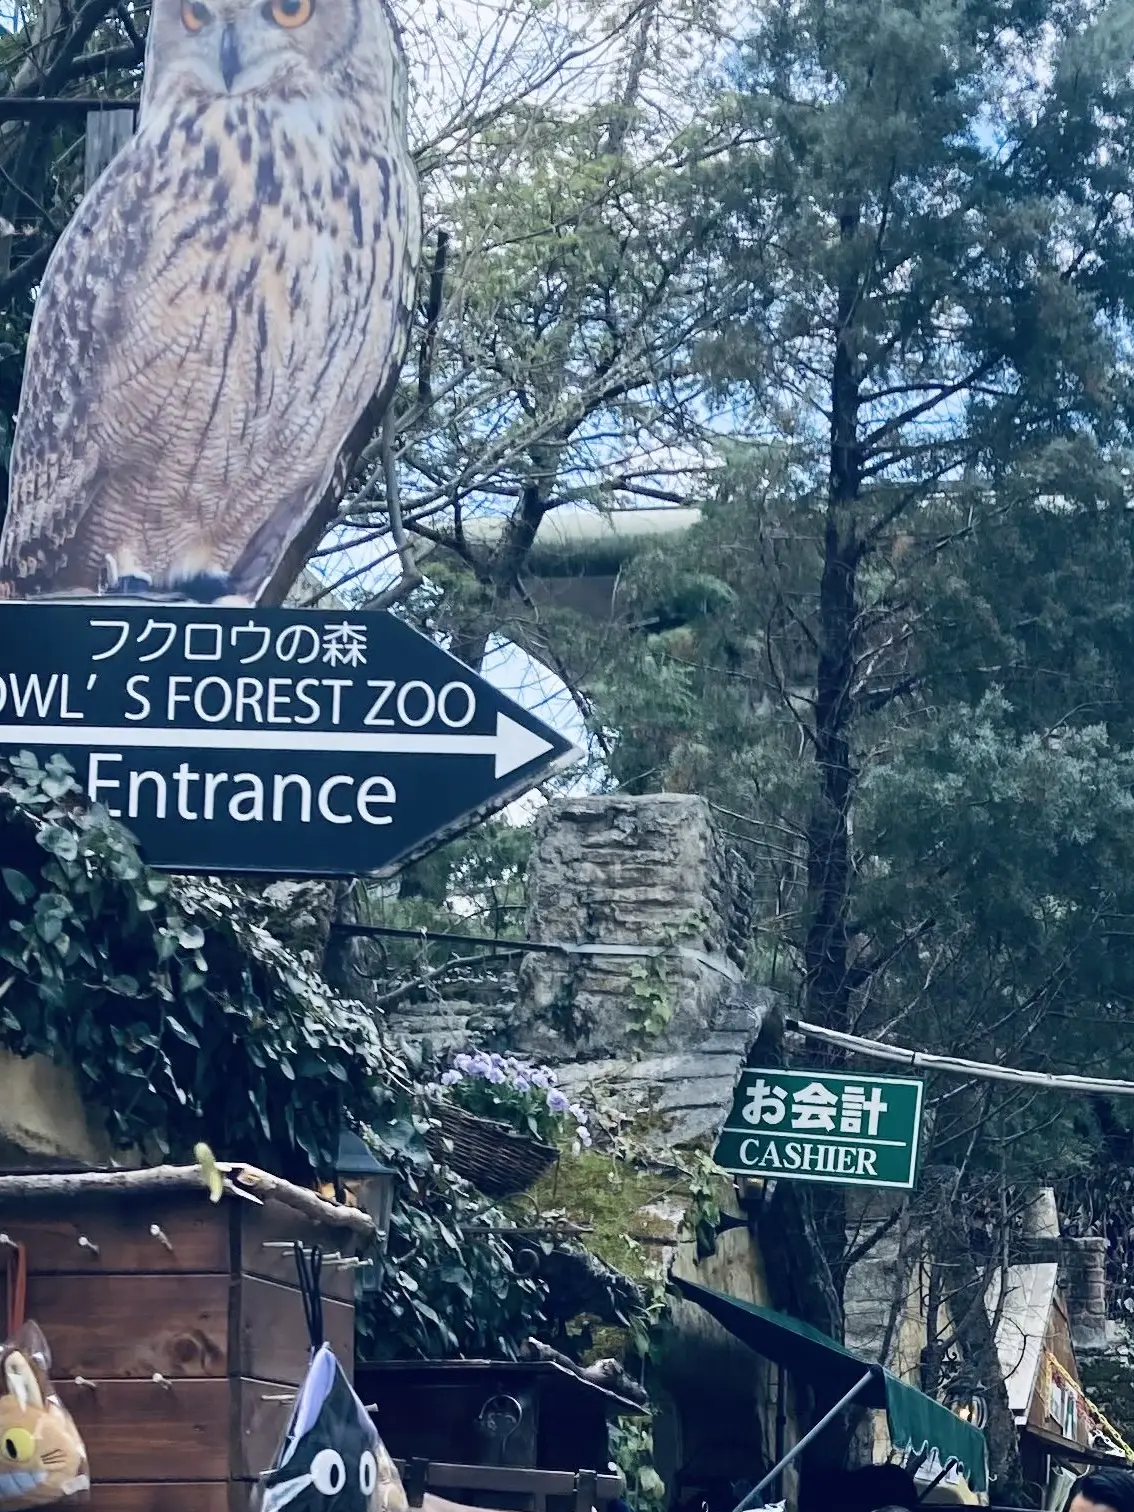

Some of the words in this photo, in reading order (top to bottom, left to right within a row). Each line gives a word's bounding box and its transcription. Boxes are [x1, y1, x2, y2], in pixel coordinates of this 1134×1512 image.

[88, 619, 368, 668] フクロウの森
[167, 675, 354, 725] FOREST
[364, 679, 477, 728] ZOO
[87, 752, 398, 826] Entrance
[741, 1078, 888, 1136] お会計
[739, 1138, 878, 1176] CASHIER
